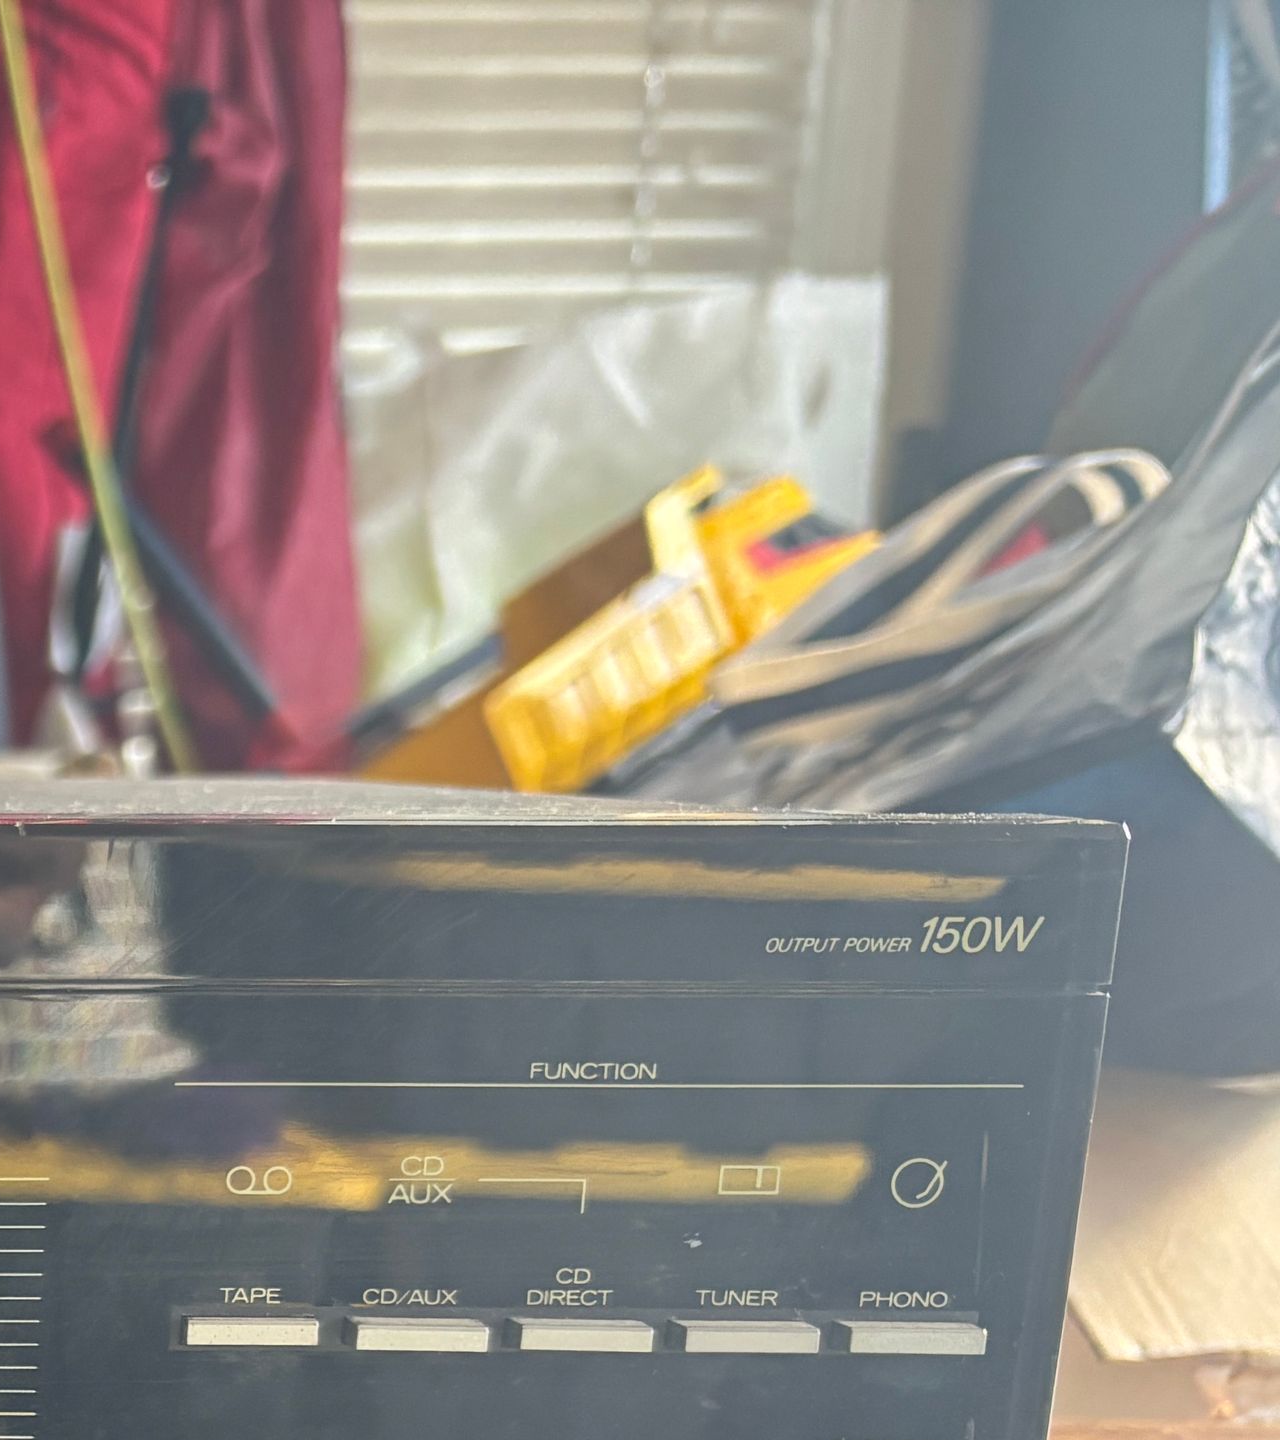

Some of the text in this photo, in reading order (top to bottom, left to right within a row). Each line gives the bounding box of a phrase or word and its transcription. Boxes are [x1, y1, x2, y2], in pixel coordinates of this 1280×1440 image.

[765, 915, 1045, 954] OUTPUT POWER 150W
[529, 1062, 657, 1081] FUNCTION
[400, 1154, 445, 1176] CD
[387, 1183, 453, 1205] AUX
[555, 1267, 592, 1285] CD
[219, 1287, 281, 1304] TAPE
[362, 1288, 458, 1306] CD/AUX
[526, 1289, 614, 1306] DIRECT
[695, 1289, 779, 1307] TUNER
[859, 1291, 949, 1308] PHONO
